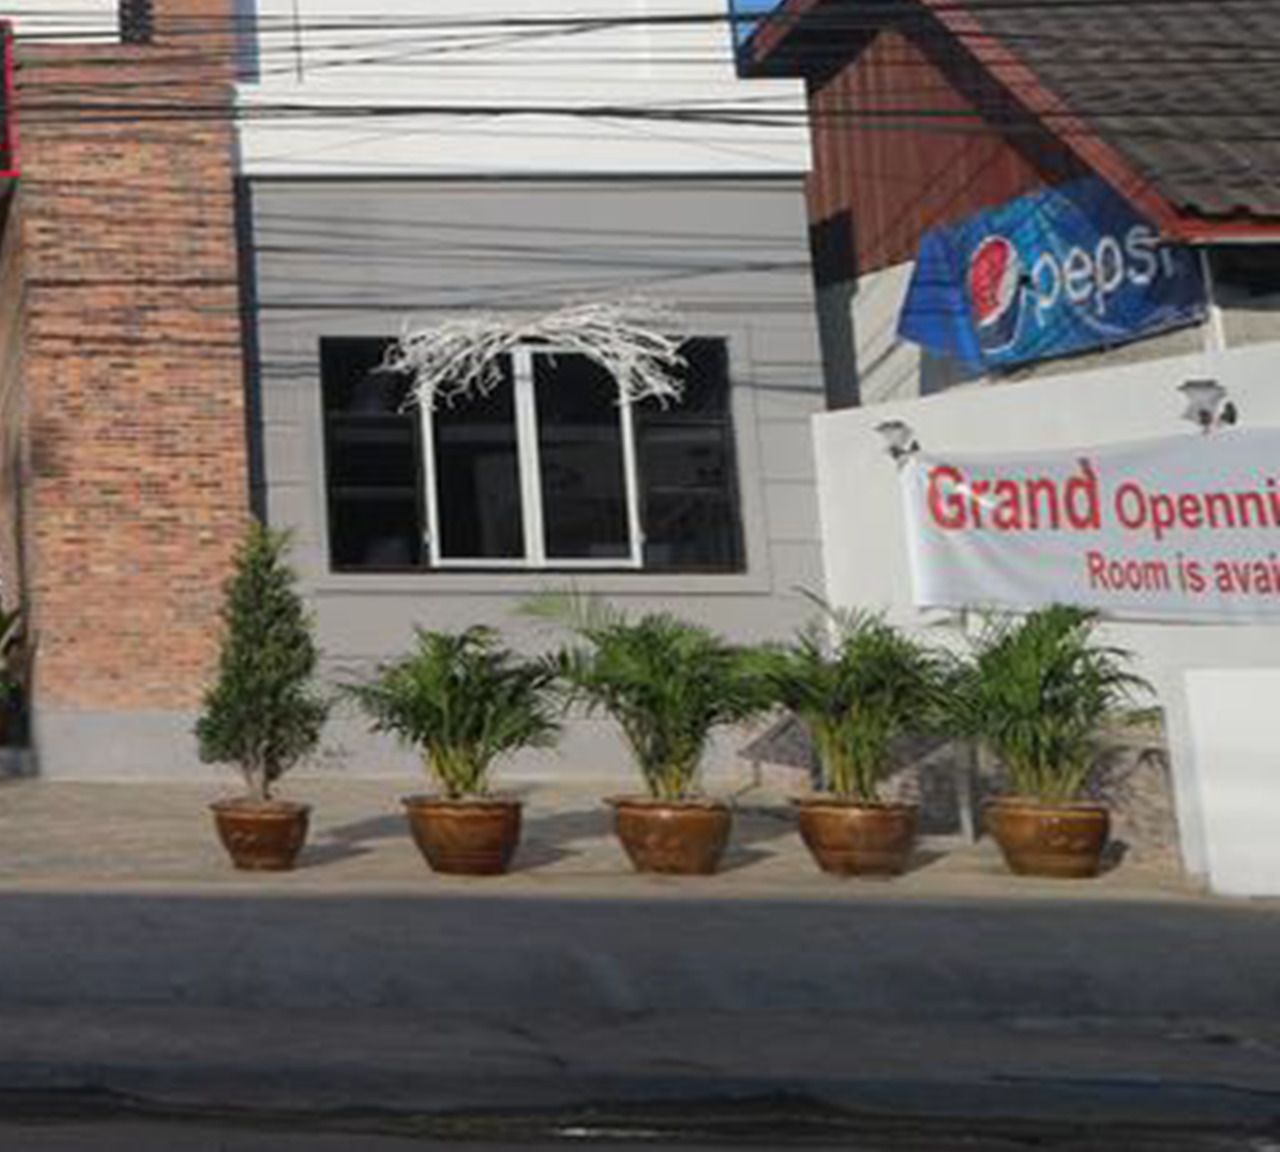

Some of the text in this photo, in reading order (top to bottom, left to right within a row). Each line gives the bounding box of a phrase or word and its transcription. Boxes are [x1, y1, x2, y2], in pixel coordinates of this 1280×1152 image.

[927, 458, 1101, 531] Grand
[1087, 550, 1170, 593] Room
[1175, 550, 1206, 594] is
